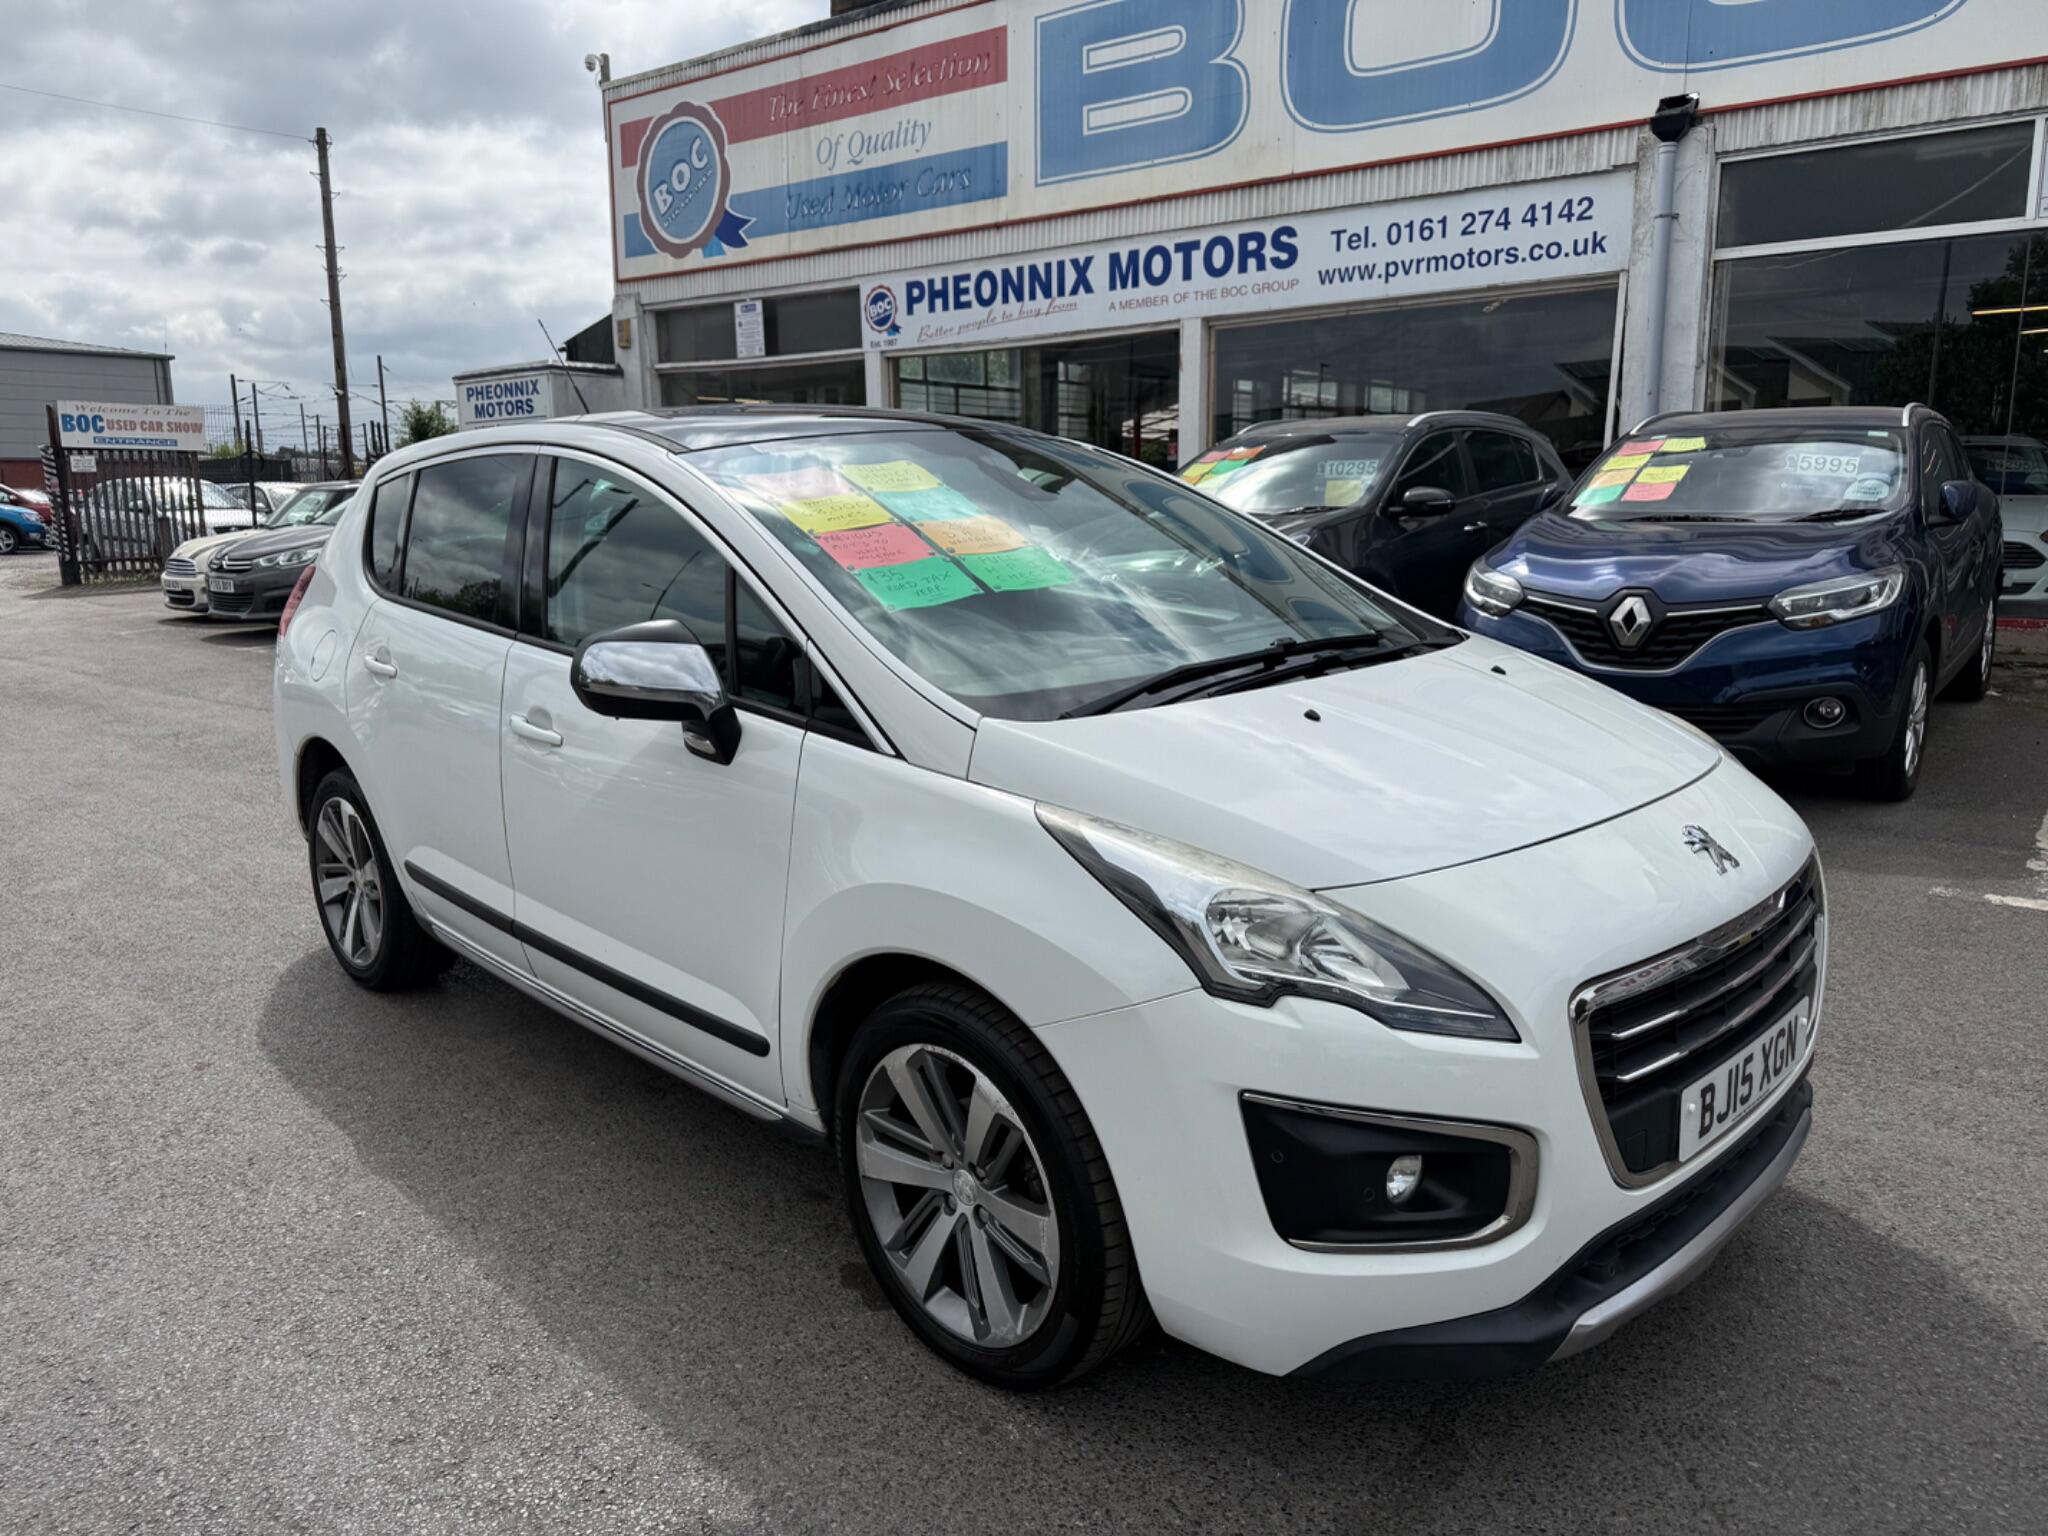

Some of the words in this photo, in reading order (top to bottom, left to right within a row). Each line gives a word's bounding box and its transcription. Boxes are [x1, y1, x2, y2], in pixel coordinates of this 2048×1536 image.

[769, 94, 804, 121] The
[810, 75, 877, 110] Finest
[882, 51, 990, 96] Selection
[815, 135, 844, 170] Of
[848, 119, 931, 165] Quality
[653, 135, 708, 216] BOC
[786, 187, 835, 220] Used
[841, 178, 908, 212] Motor
[916, 167, 971, 197] Cars
[1331, 227, 1377, 252] Tel.
[1387, 215, 1448, 246] 0161
[1460, 207, 1511, 236] 274
[1521, 196, 1594, 228] 4142
[905, 255, 1094, 316] PHEONNIX
[1108, 225, 1298, 291] MOTORS
[1318, 231, 1608, 285] www.pvrmotors.co.uk
[869, 297, 892, 316] BOC
[916, 320, 954, 343] Better
[957, 308, 997, 331] people
[1001, 309, 1013, 321] to
[1017, 301, 1046, 319] buy
[1045, 296, 1079, 316] from
[1108, 302, 1117, 311] A
[1120, 296, 1168, 310] MEMBER
[1173, 292, 1191, 303] OF
[1194, 288, 1217, 301] THE
[1220, 285, 1248, 298] BOC
[1251, 279, 1299, 295] GROUP
[75, 404, 138, 415] Welcome
[143, 407, 160, 416] To
[165, 408, 191, 417] The
[466, 379, 540, 402] PHEONNIX
[474, 398, 534, 419] MOTORS
[61, 413, 105, 433] BOC
[106, 418, 137, 431] USED
[140, 420, 164, 432] CAR
[166, 421, 203, 434] SHOW
[95, 437, 176, 446] ENTRANCE
[1698, 1052, 1754, 1139] BJ15
[1759, 1014, 1798, 1092] XGN
